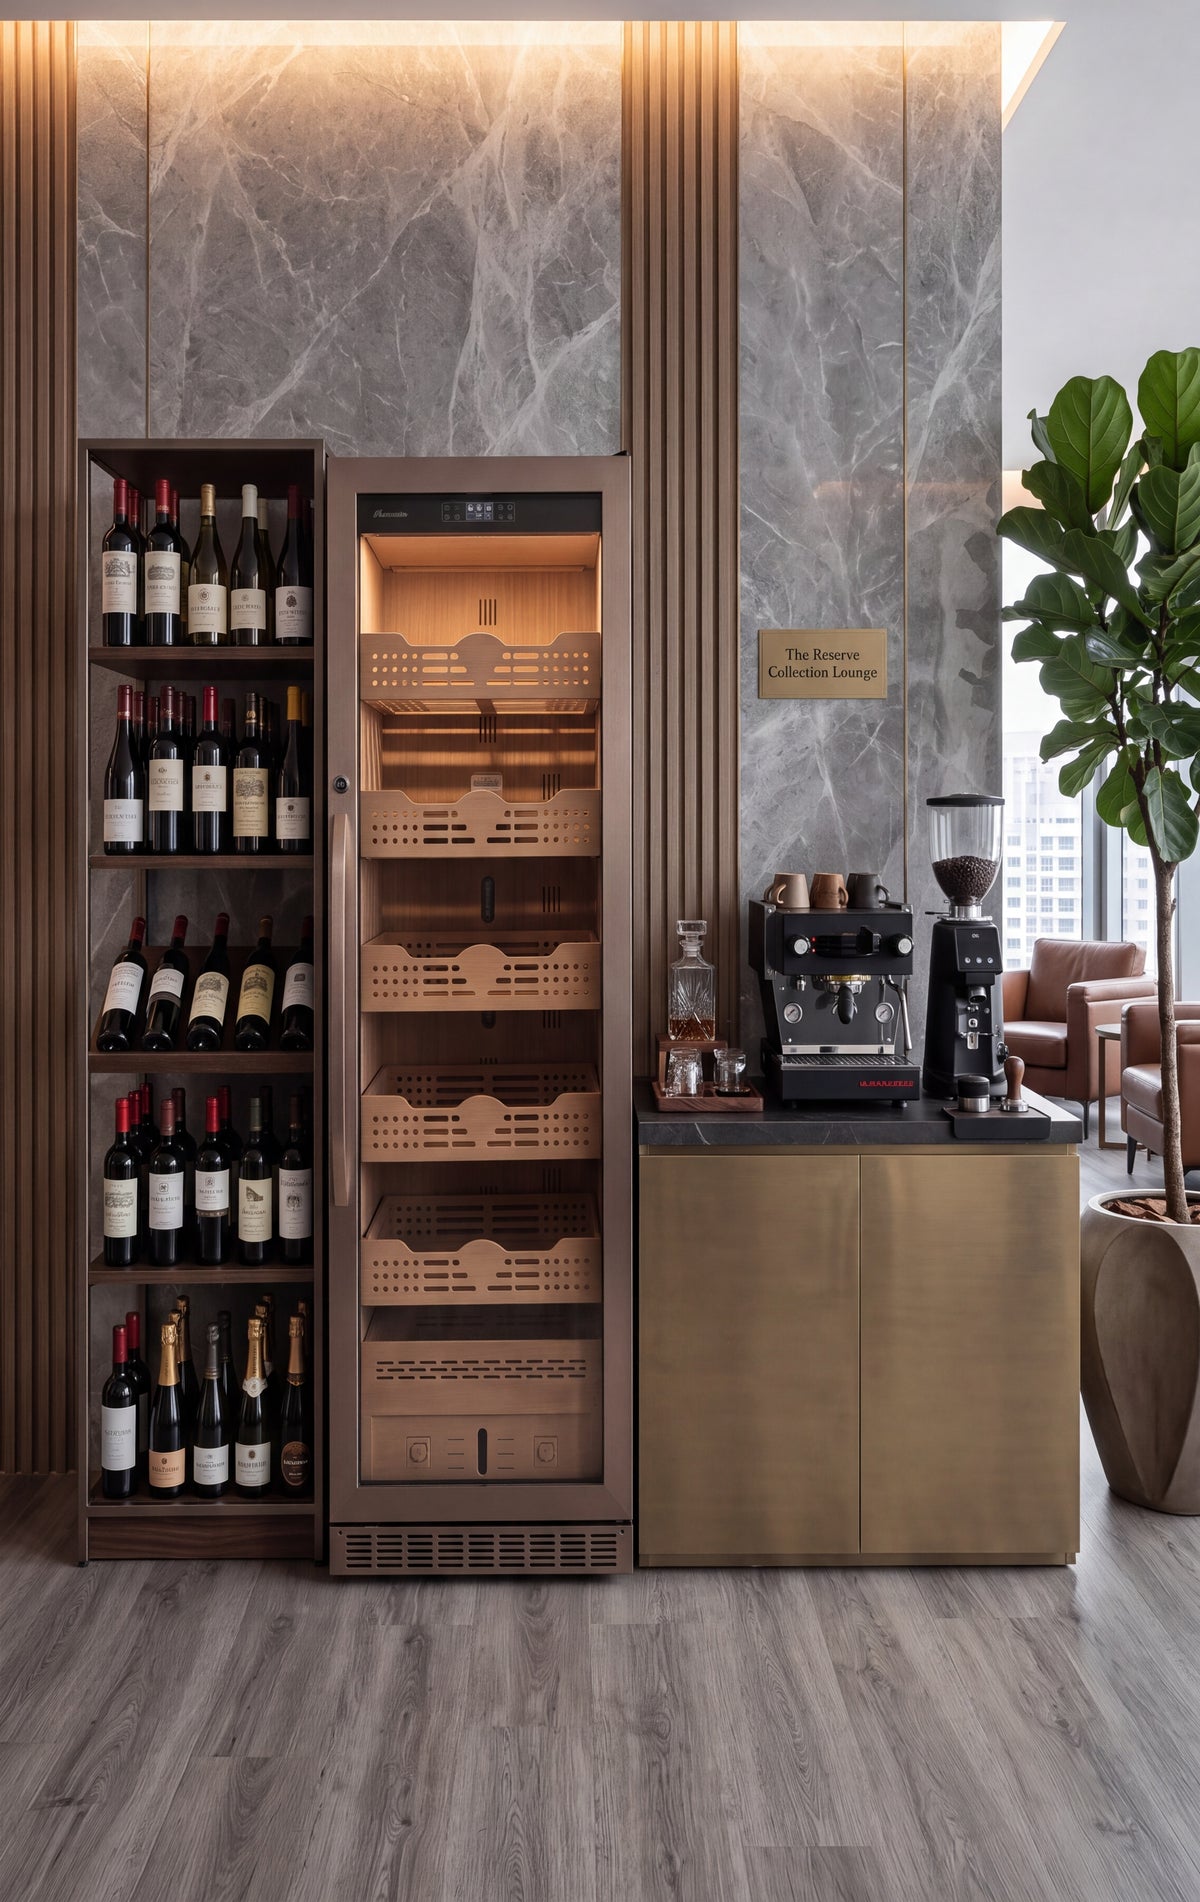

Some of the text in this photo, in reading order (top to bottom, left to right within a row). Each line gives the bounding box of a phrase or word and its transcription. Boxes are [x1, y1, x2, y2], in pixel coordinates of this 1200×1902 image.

[785, 648, 860, 661] The Reserve
[768, 665, 878, 681] Collection Lounge
